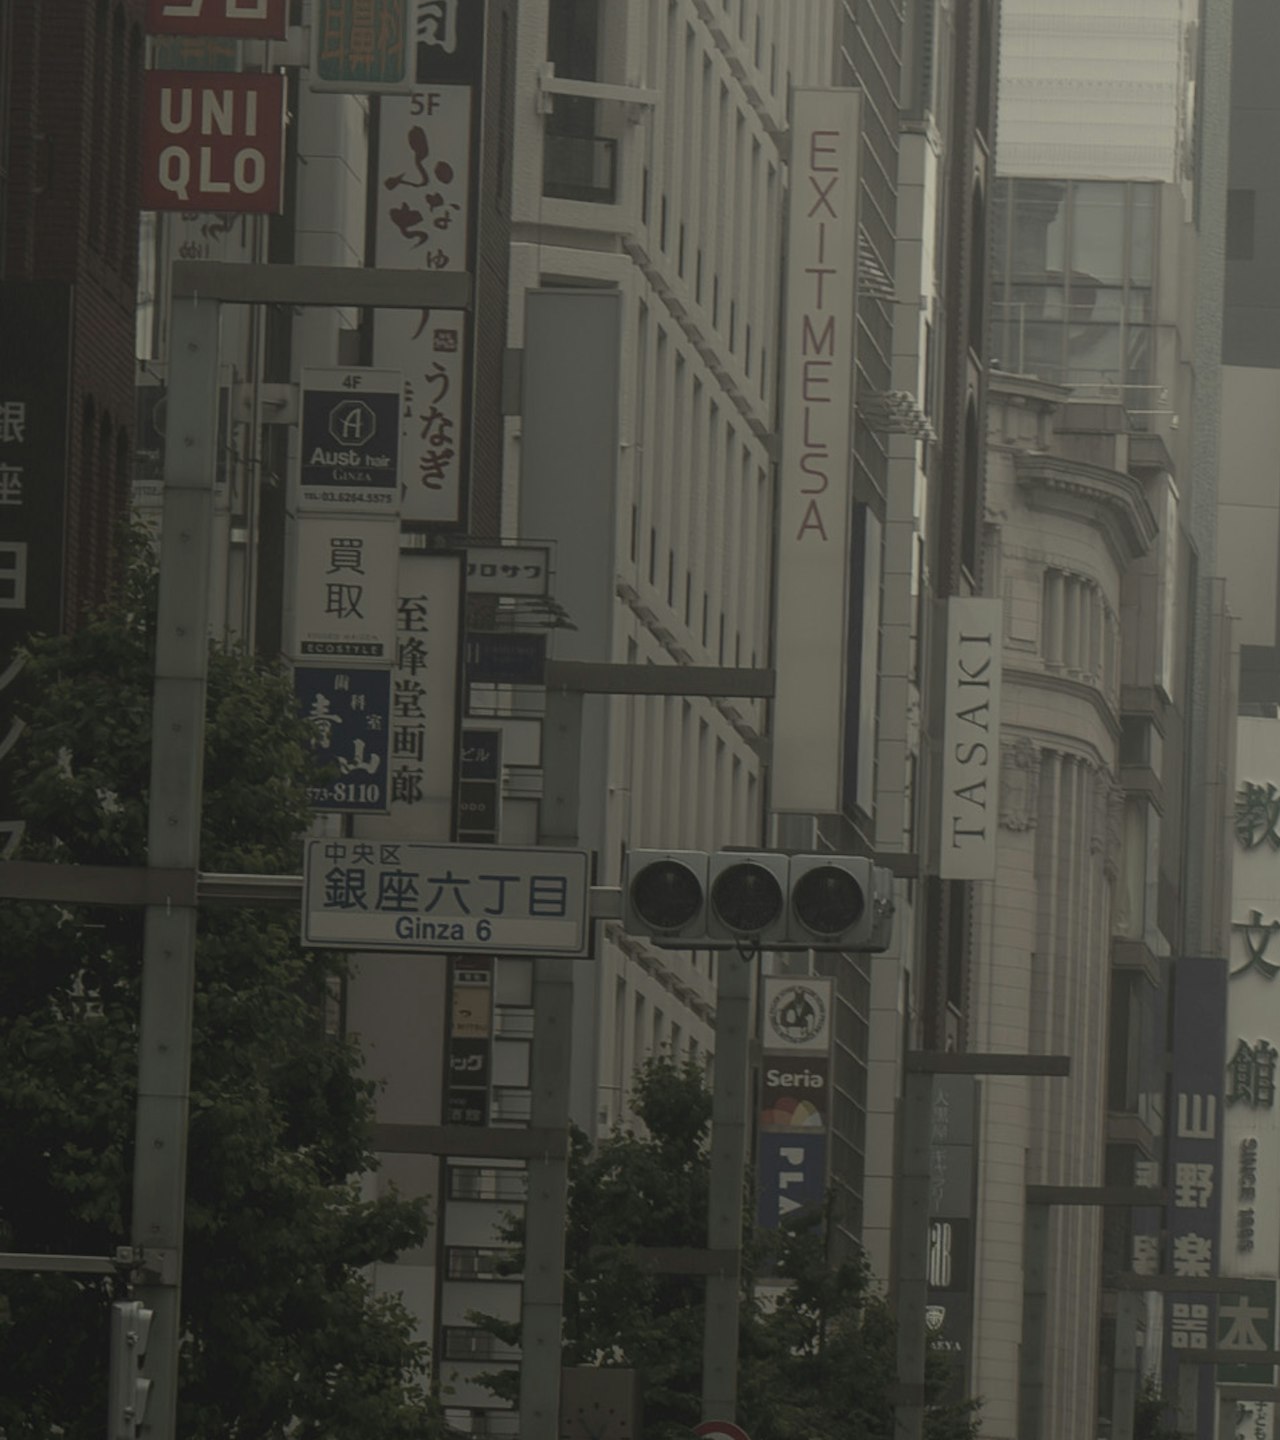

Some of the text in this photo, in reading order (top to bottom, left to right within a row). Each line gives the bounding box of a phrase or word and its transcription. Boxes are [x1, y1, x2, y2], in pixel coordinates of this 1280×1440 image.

[160, 88, 257, 136] UNI
[410, 93, 440, 116] 5F
[158, 145, 266, 201] QLO
[796, 130, 840, 542] EXITMELSA
[419, 361, 456, 490] うなぎ
[325, 537, 366, 620] 買取
[952, 631, 993, 847] TASAKI
[324, 842, 402, 867] 中央区
[323, 866, 568, 918] 銀座六丁目
[395, 916, 493, 941] Ginza 6
[766, 1069, 825, 1089] Seria
[1170, 1092, 1217, 1350] 山野楽器
[1216, 1295, 1271, 1351] 本
